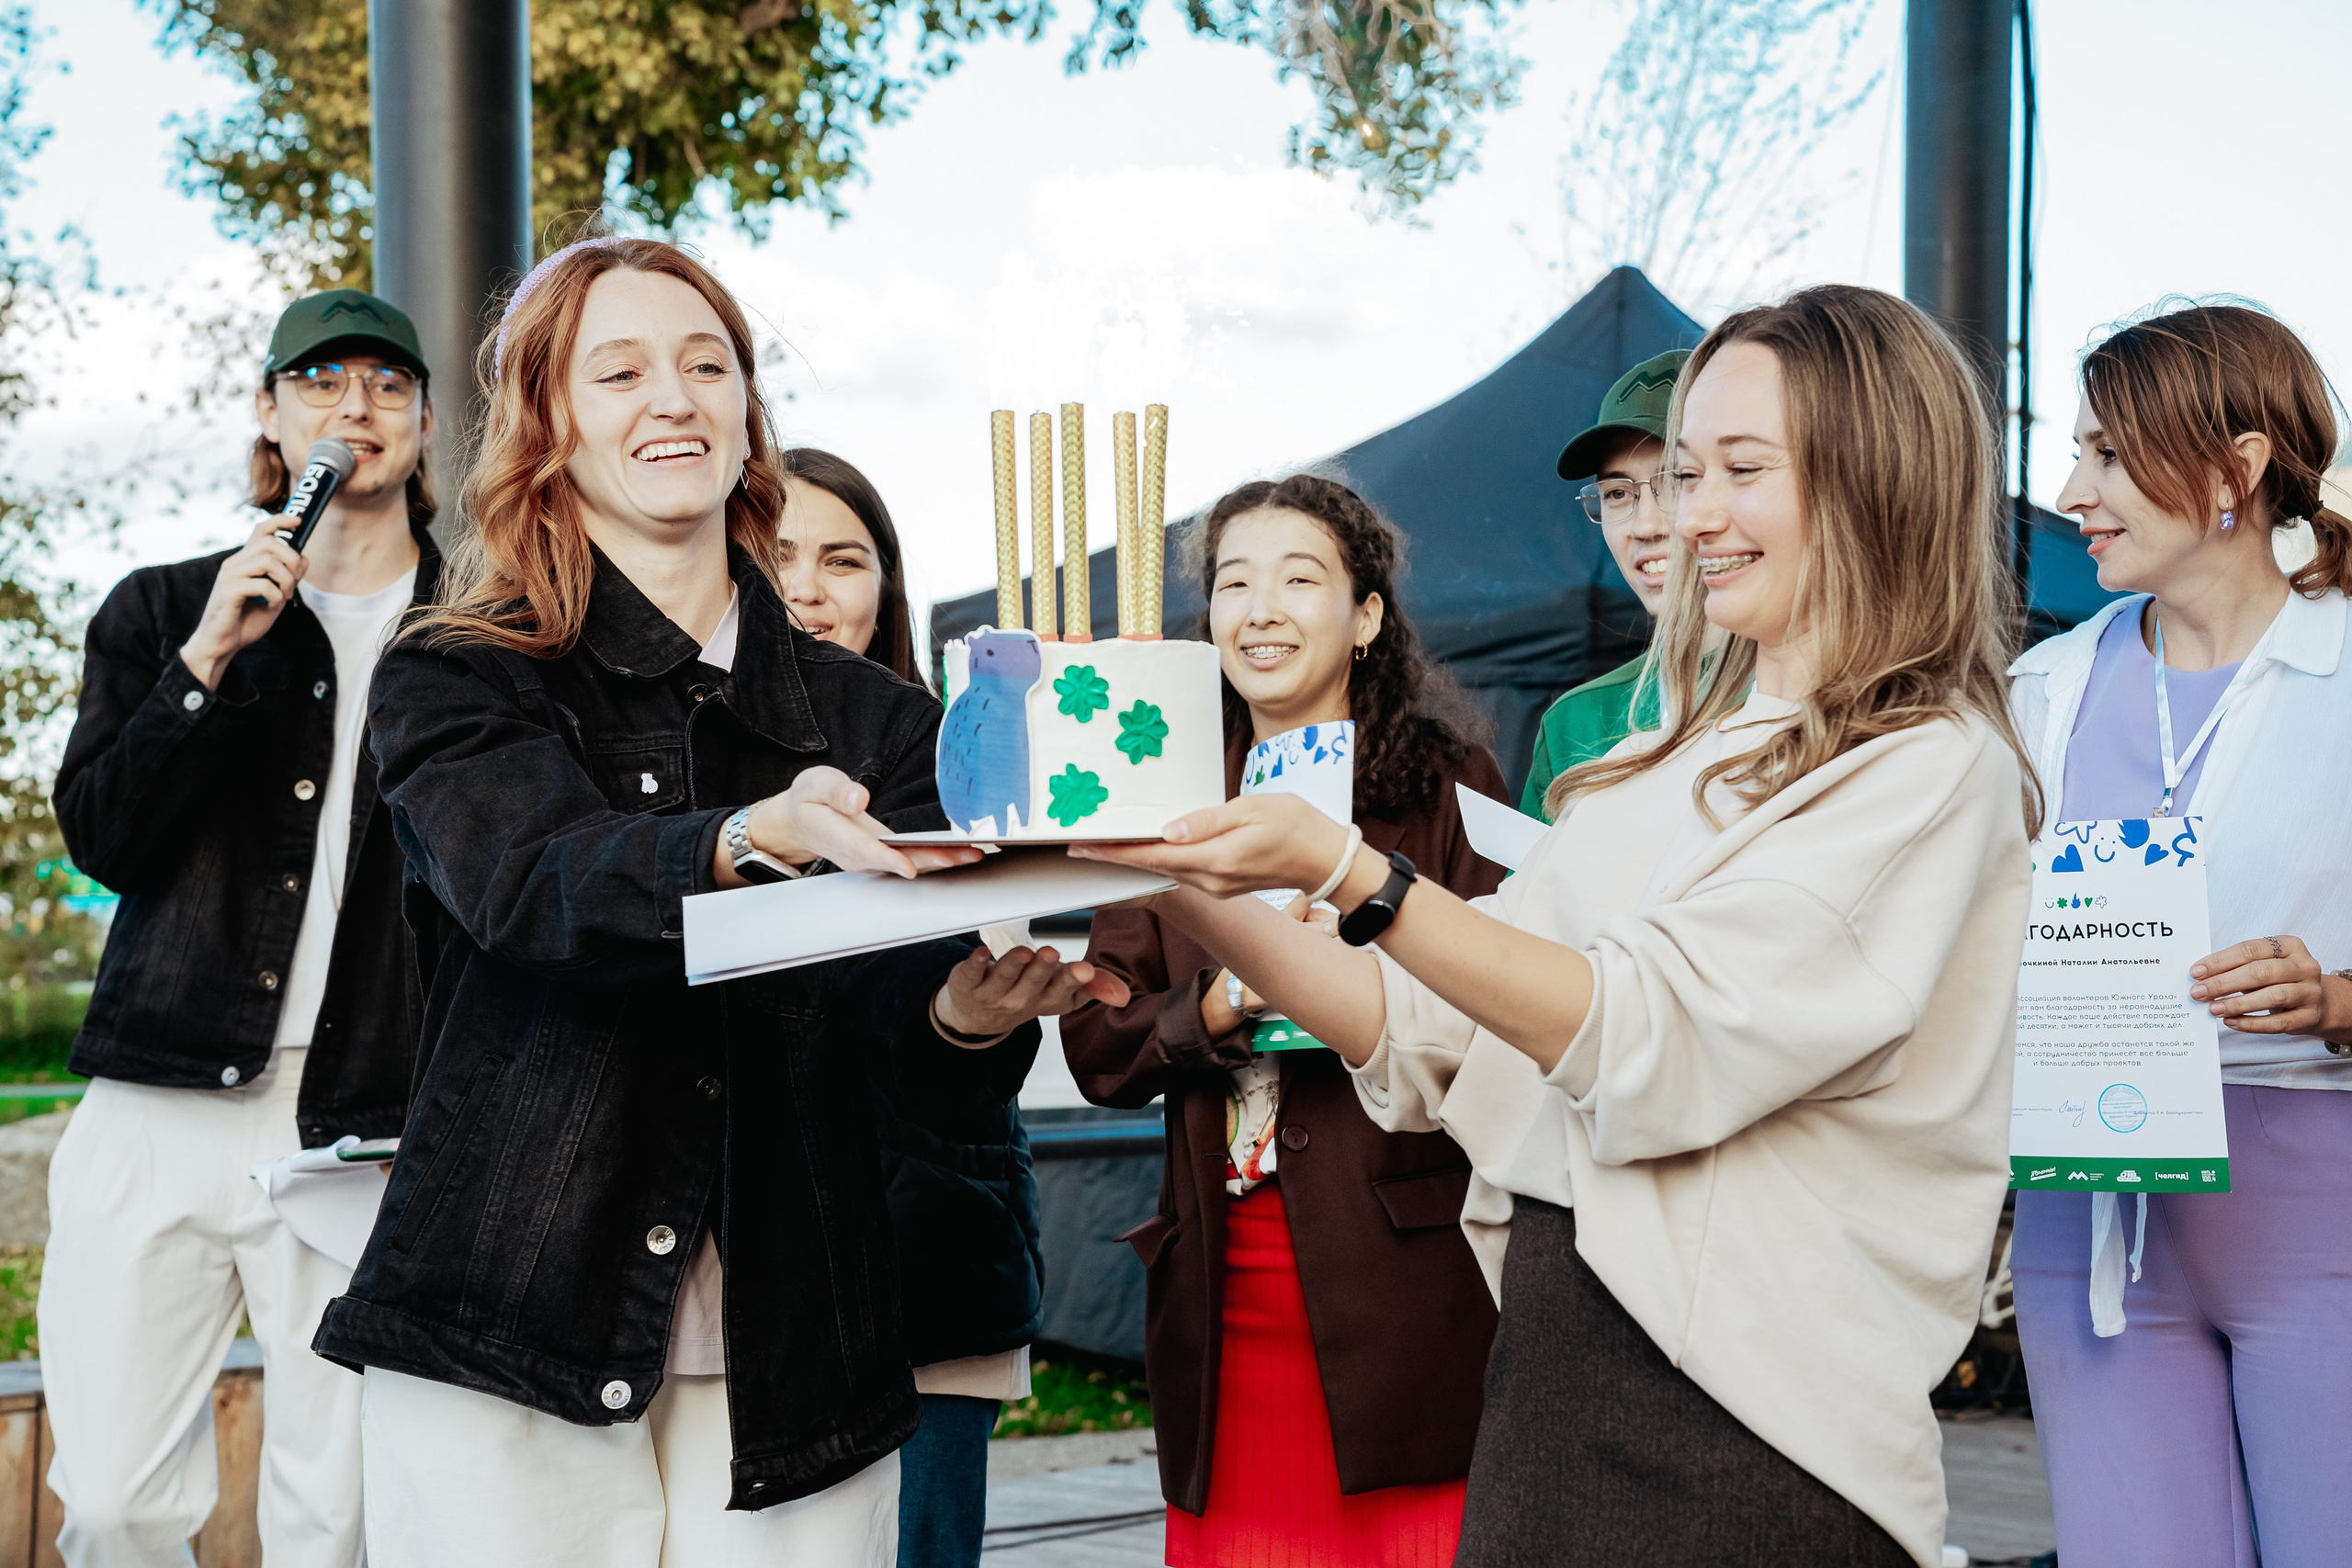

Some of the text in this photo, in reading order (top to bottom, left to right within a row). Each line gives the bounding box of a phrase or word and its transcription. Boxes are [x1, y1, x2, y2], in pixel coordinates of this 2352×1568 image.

[2025, 921, 2174, 942] ГОДАРНОСТЬ
[2046, 1003, 2106, 1011] благодарность
[2119, 1003, 2183, 1011] неравнодушие
[2133, 1021, 2165, 1030] добрых
[2077, 1041, 2109, 1049] дружба
[2102, 1059, 2143, 1067] проектов.
